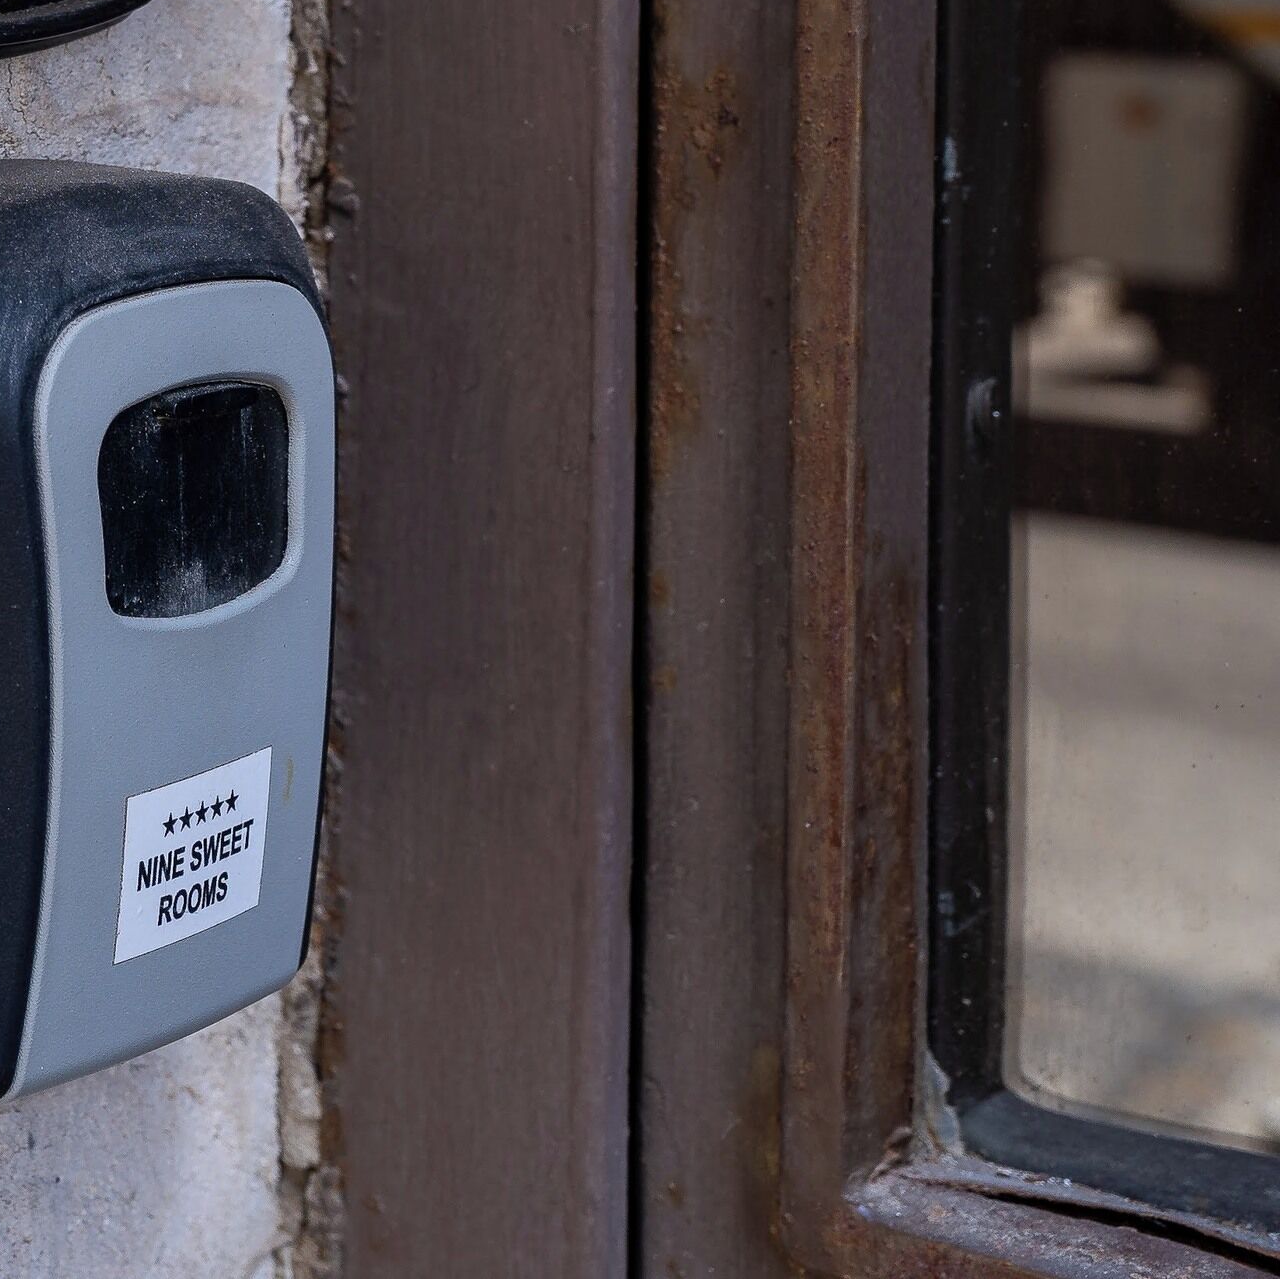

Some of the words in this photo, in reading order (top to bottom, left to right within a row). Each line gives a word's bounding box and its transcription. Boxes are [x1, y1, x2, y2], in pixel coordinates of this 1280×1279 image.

[136, 846, 186, 893] NINE
[190, 818, 255, 873] SWEET
[157, 871, 230, 927] ROOMS
